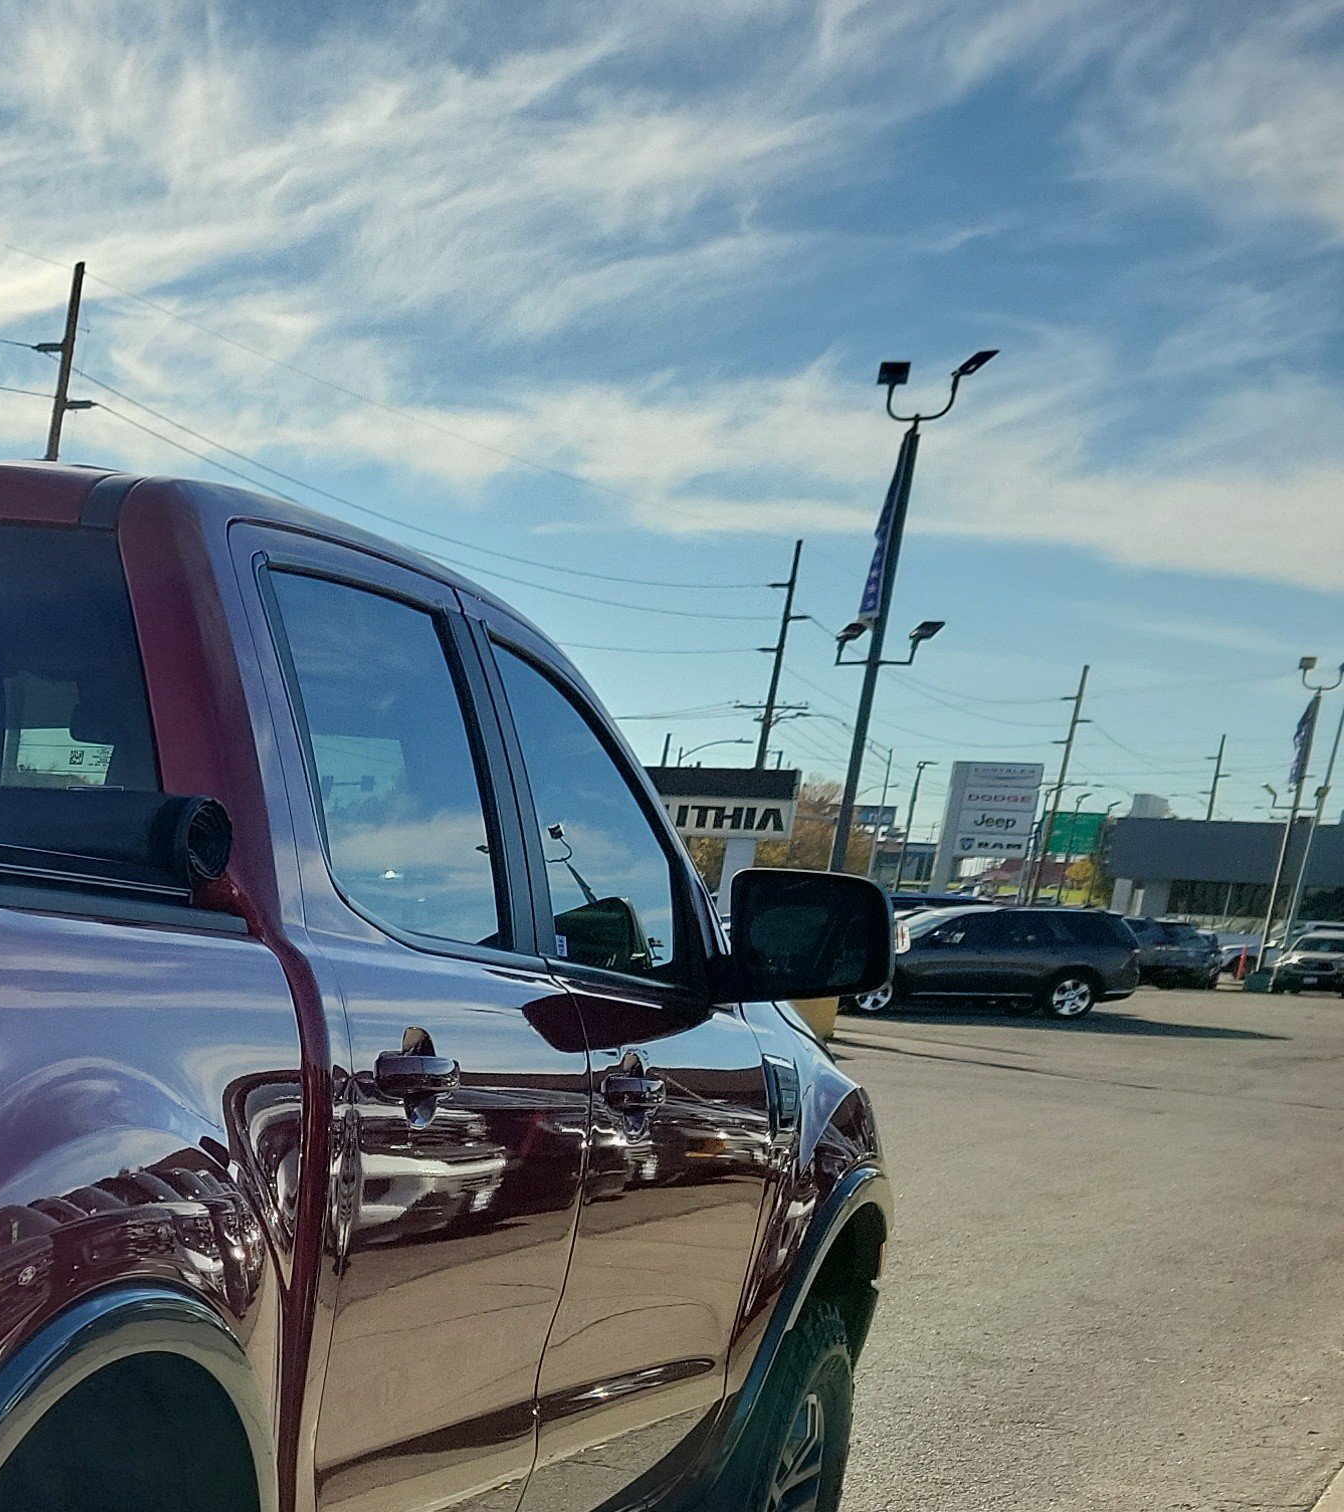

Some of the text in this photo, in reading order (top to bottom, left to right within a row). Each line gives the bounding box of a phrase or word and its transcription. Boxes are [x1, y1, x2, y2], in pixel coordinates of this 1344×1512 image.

[968, 794, 1032, 803] DODGE
[665, 804, 784, 832] ITHIA
[973, 813, 1016, 830] Jeep
[977, 841, 1023, 850] RAM
